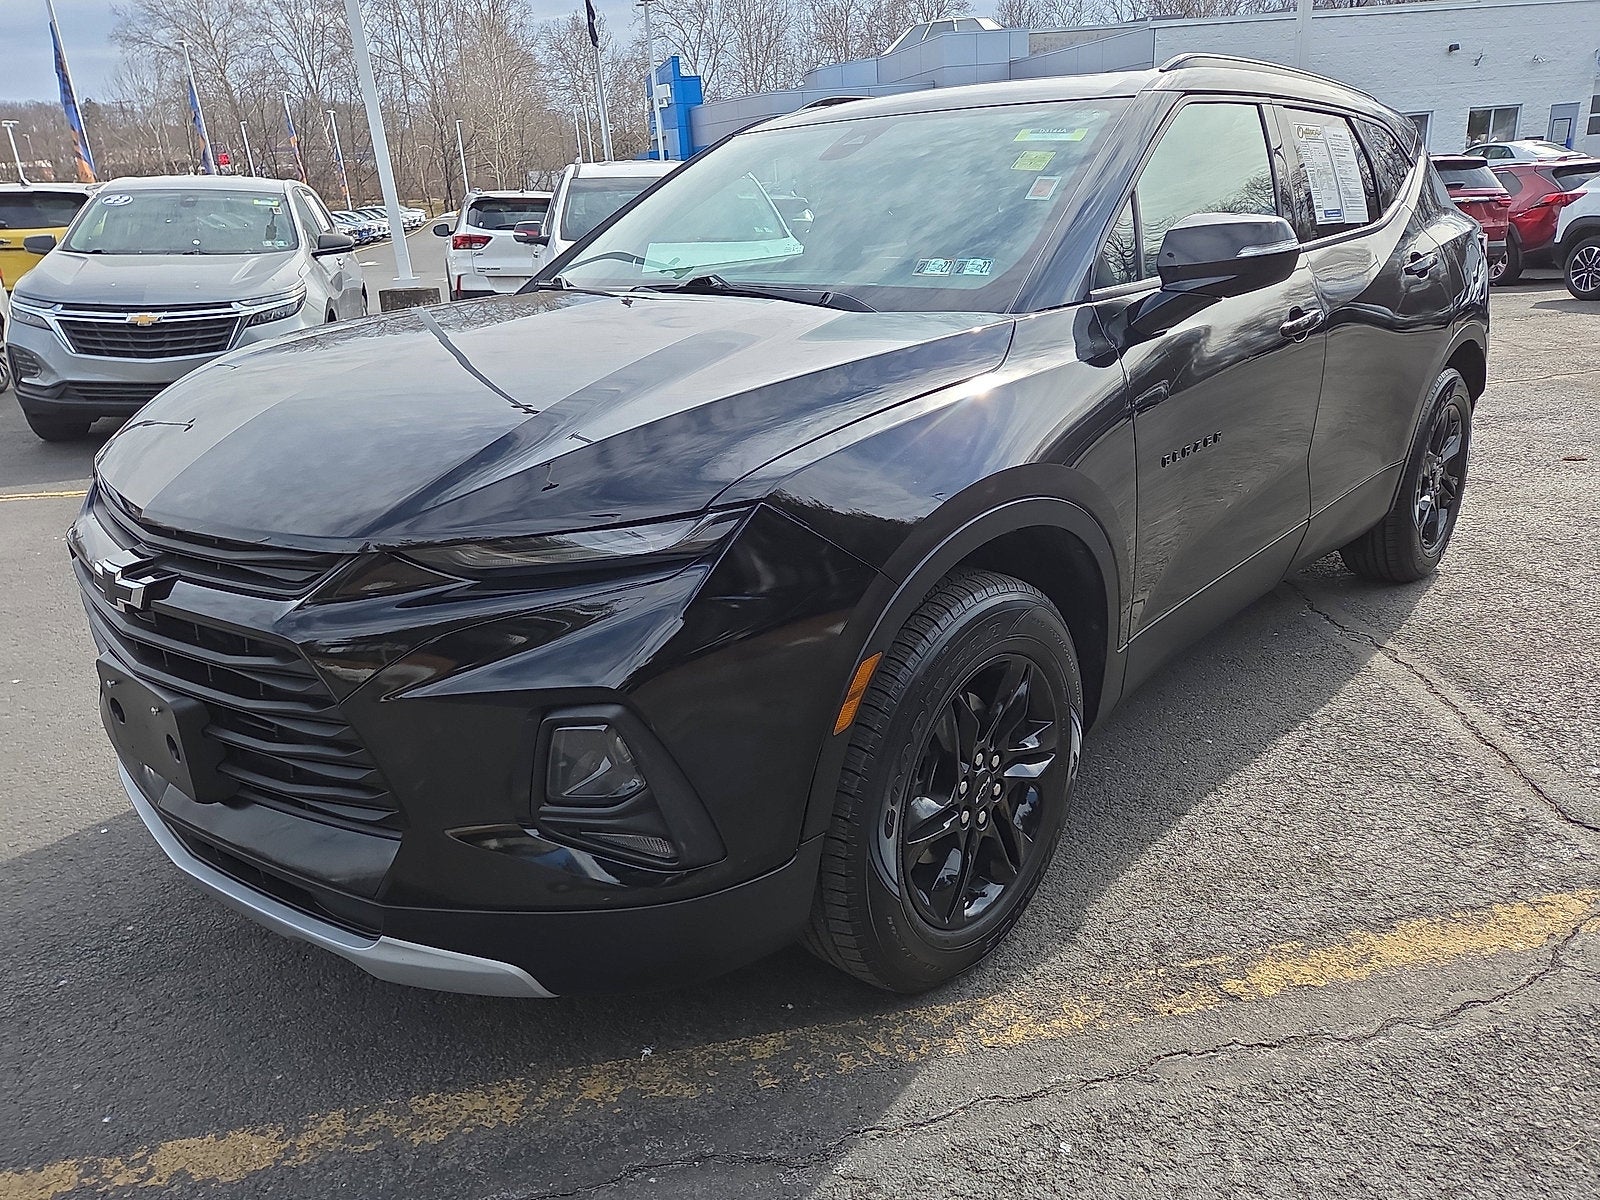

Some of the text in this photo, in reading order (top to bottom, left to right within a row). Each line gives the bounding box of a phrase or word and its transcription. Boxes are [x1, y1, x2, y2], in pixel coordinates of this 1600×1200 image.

[940, 260, 953, 273] 27
[980, 260, 992, 273] 27
[1161, 430, 1222, 468] BLAZER
